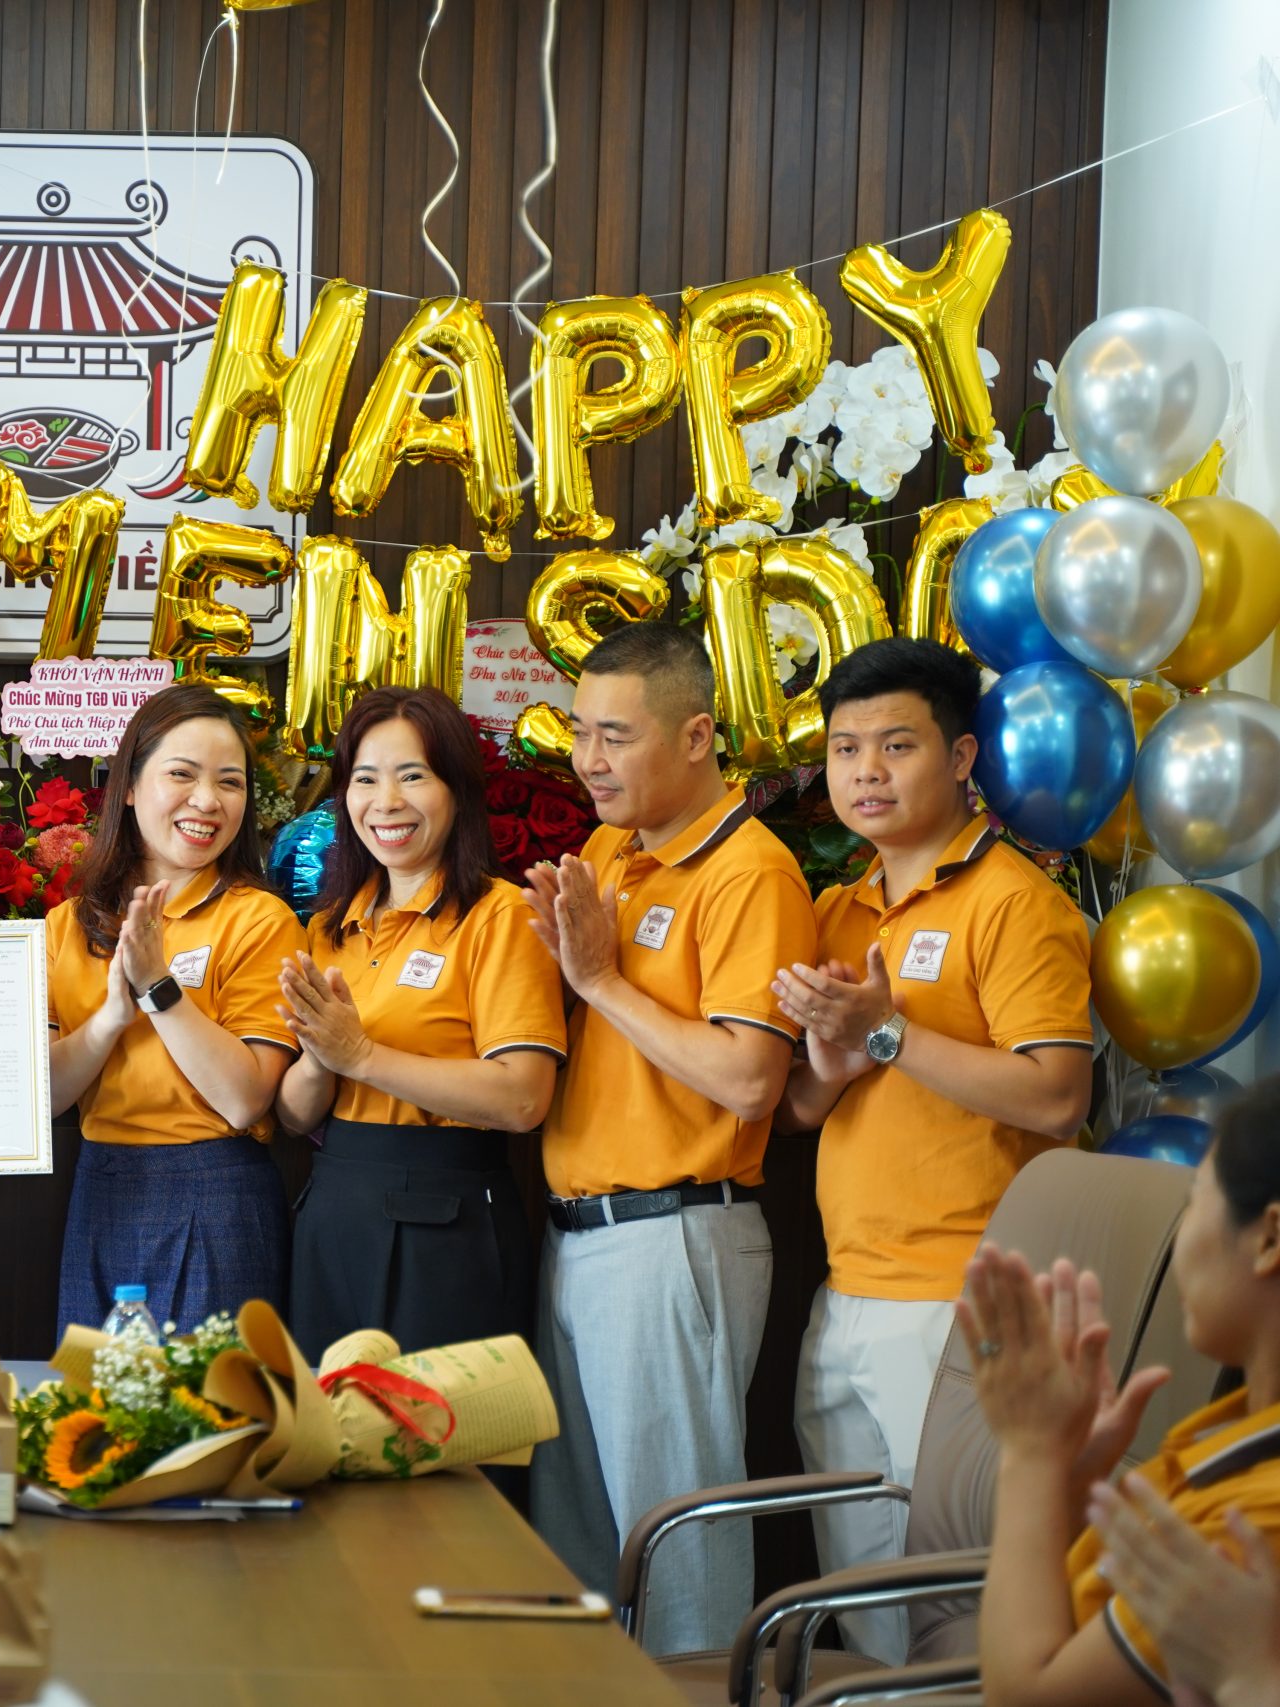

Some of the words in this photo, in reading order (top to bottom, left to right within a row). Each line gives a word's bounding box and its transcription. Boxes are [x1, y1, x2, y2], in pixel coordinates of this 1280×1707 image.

[184, 207, 1012, 560] HAPPY
[472, 644, 505, 660] Chúc
[37, 662, 78, 681] KHỐI
[80, 663, 116, 685] VẬN
[118, 663, 165, 683] HÀNH
[469, 666, 496, 682] Phụ
[530, 668, 556, 684] Việt
[9, 689, 41, 706] Chúc
[44, 689, 82, 708] Mừng
[86, 691, 108, 707] TGĐ
[112, 690, 128, 707] Vũ
[493, 688, 530, 704] 20/10
[7, 715, 32, 728] Phó
[34, 714, 59, 728] Chủ
[61, 715, 84, 732] tịch
[87, 715, 116, 732] Hiệp
[53, 736, 81, 751] thực
[83, 735, 108, 748] tỉnh
